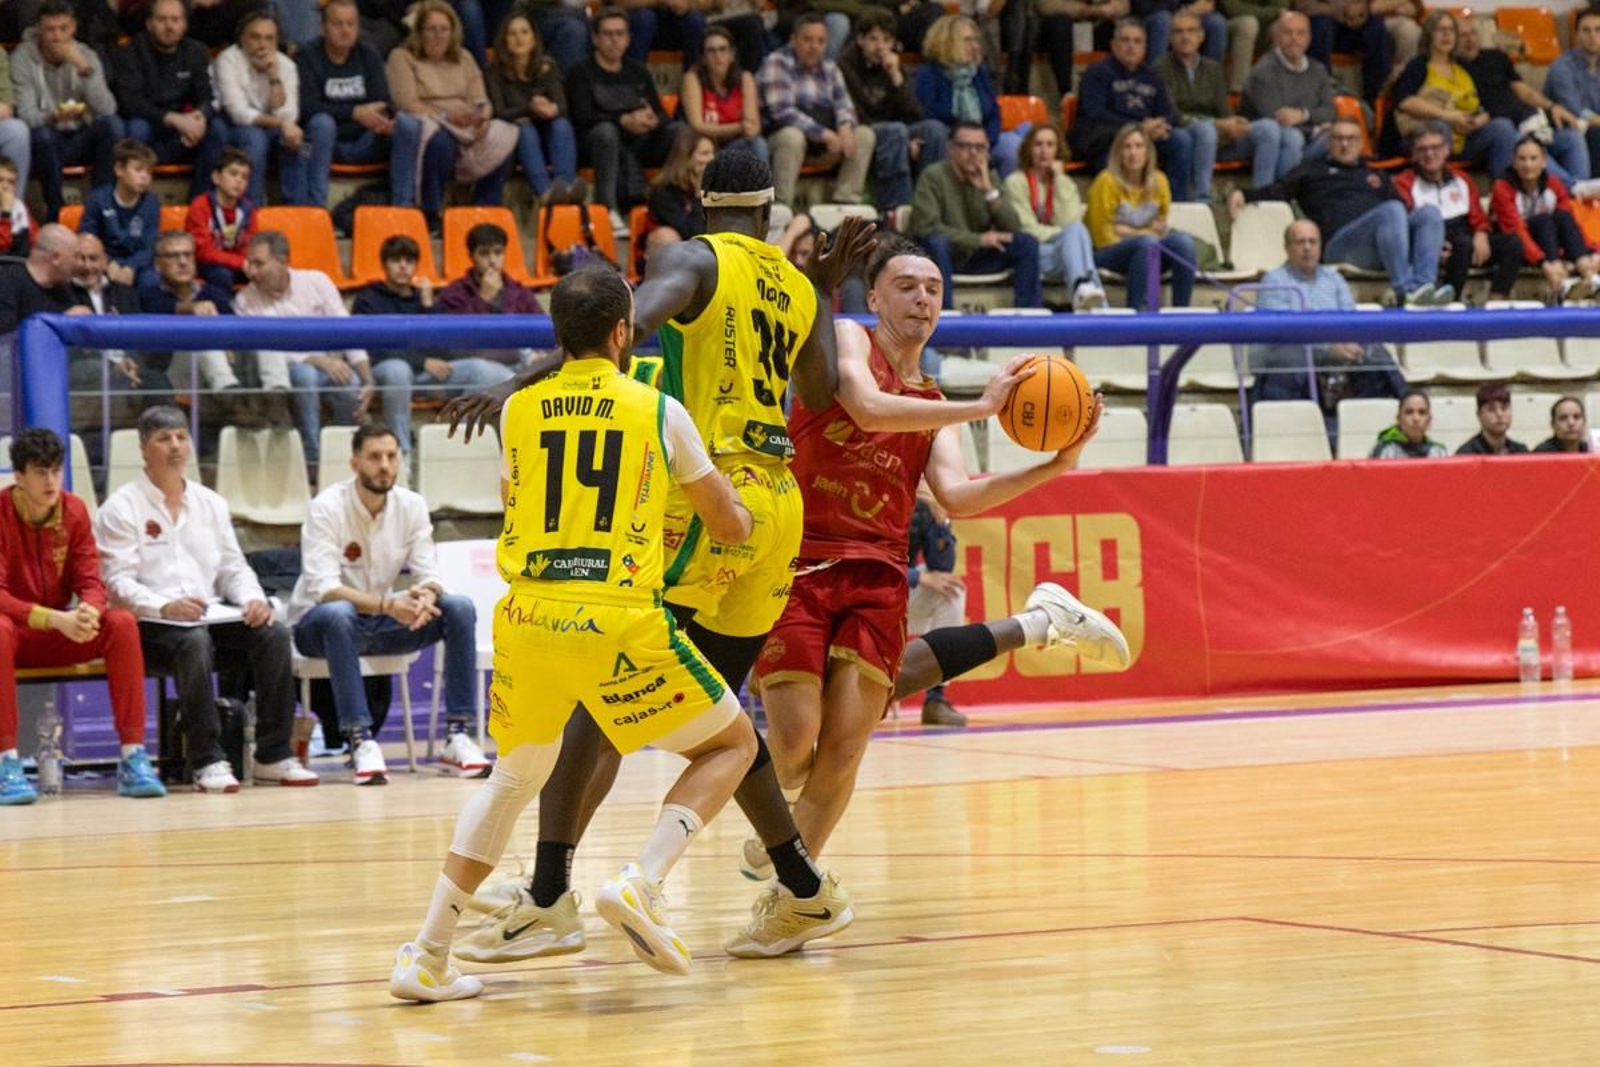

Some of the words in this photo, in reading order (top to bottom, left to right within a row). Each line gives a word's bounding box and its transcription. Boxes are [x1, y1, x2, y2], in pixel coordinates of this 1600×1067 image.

[724, 306, 736, 370] RUSTER
[541, 396, 593, 419] DAVID
[594, 398, 615, 420] M.
[540, 429, 624, 533] 14
[601, 674, 667, 704] Blanca
[613, 700, 673, 726] cajasur
